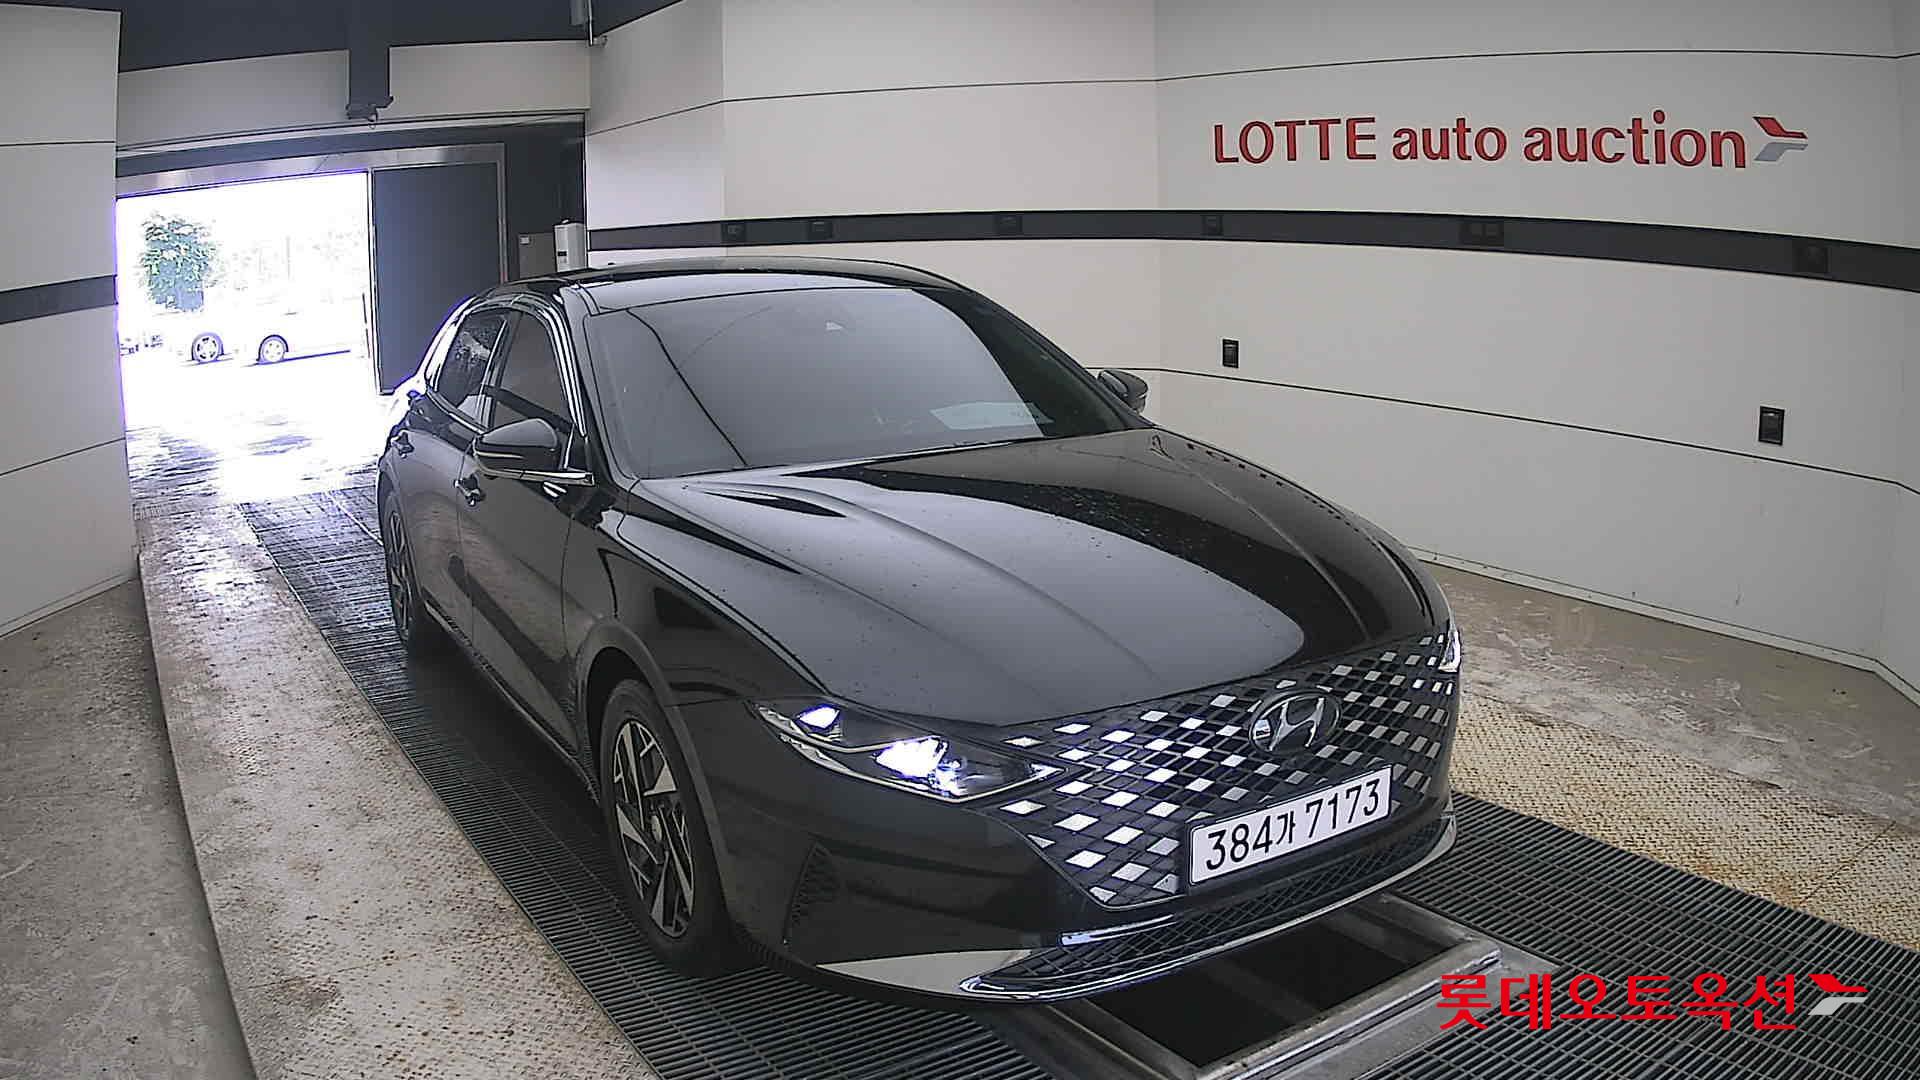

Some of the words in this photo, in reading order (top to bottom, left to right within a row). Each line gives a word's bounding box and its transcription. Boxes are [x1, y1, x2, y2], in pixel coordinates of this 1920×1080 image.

[1213, 117, 1376, 164] LOTTE
[1392, 117, 1507, 162] auto
[1523, 109, 1747, 169] auction
[1206, 811, 1296, 870] 384가
[1305, 778, 1381, 838] 7173
